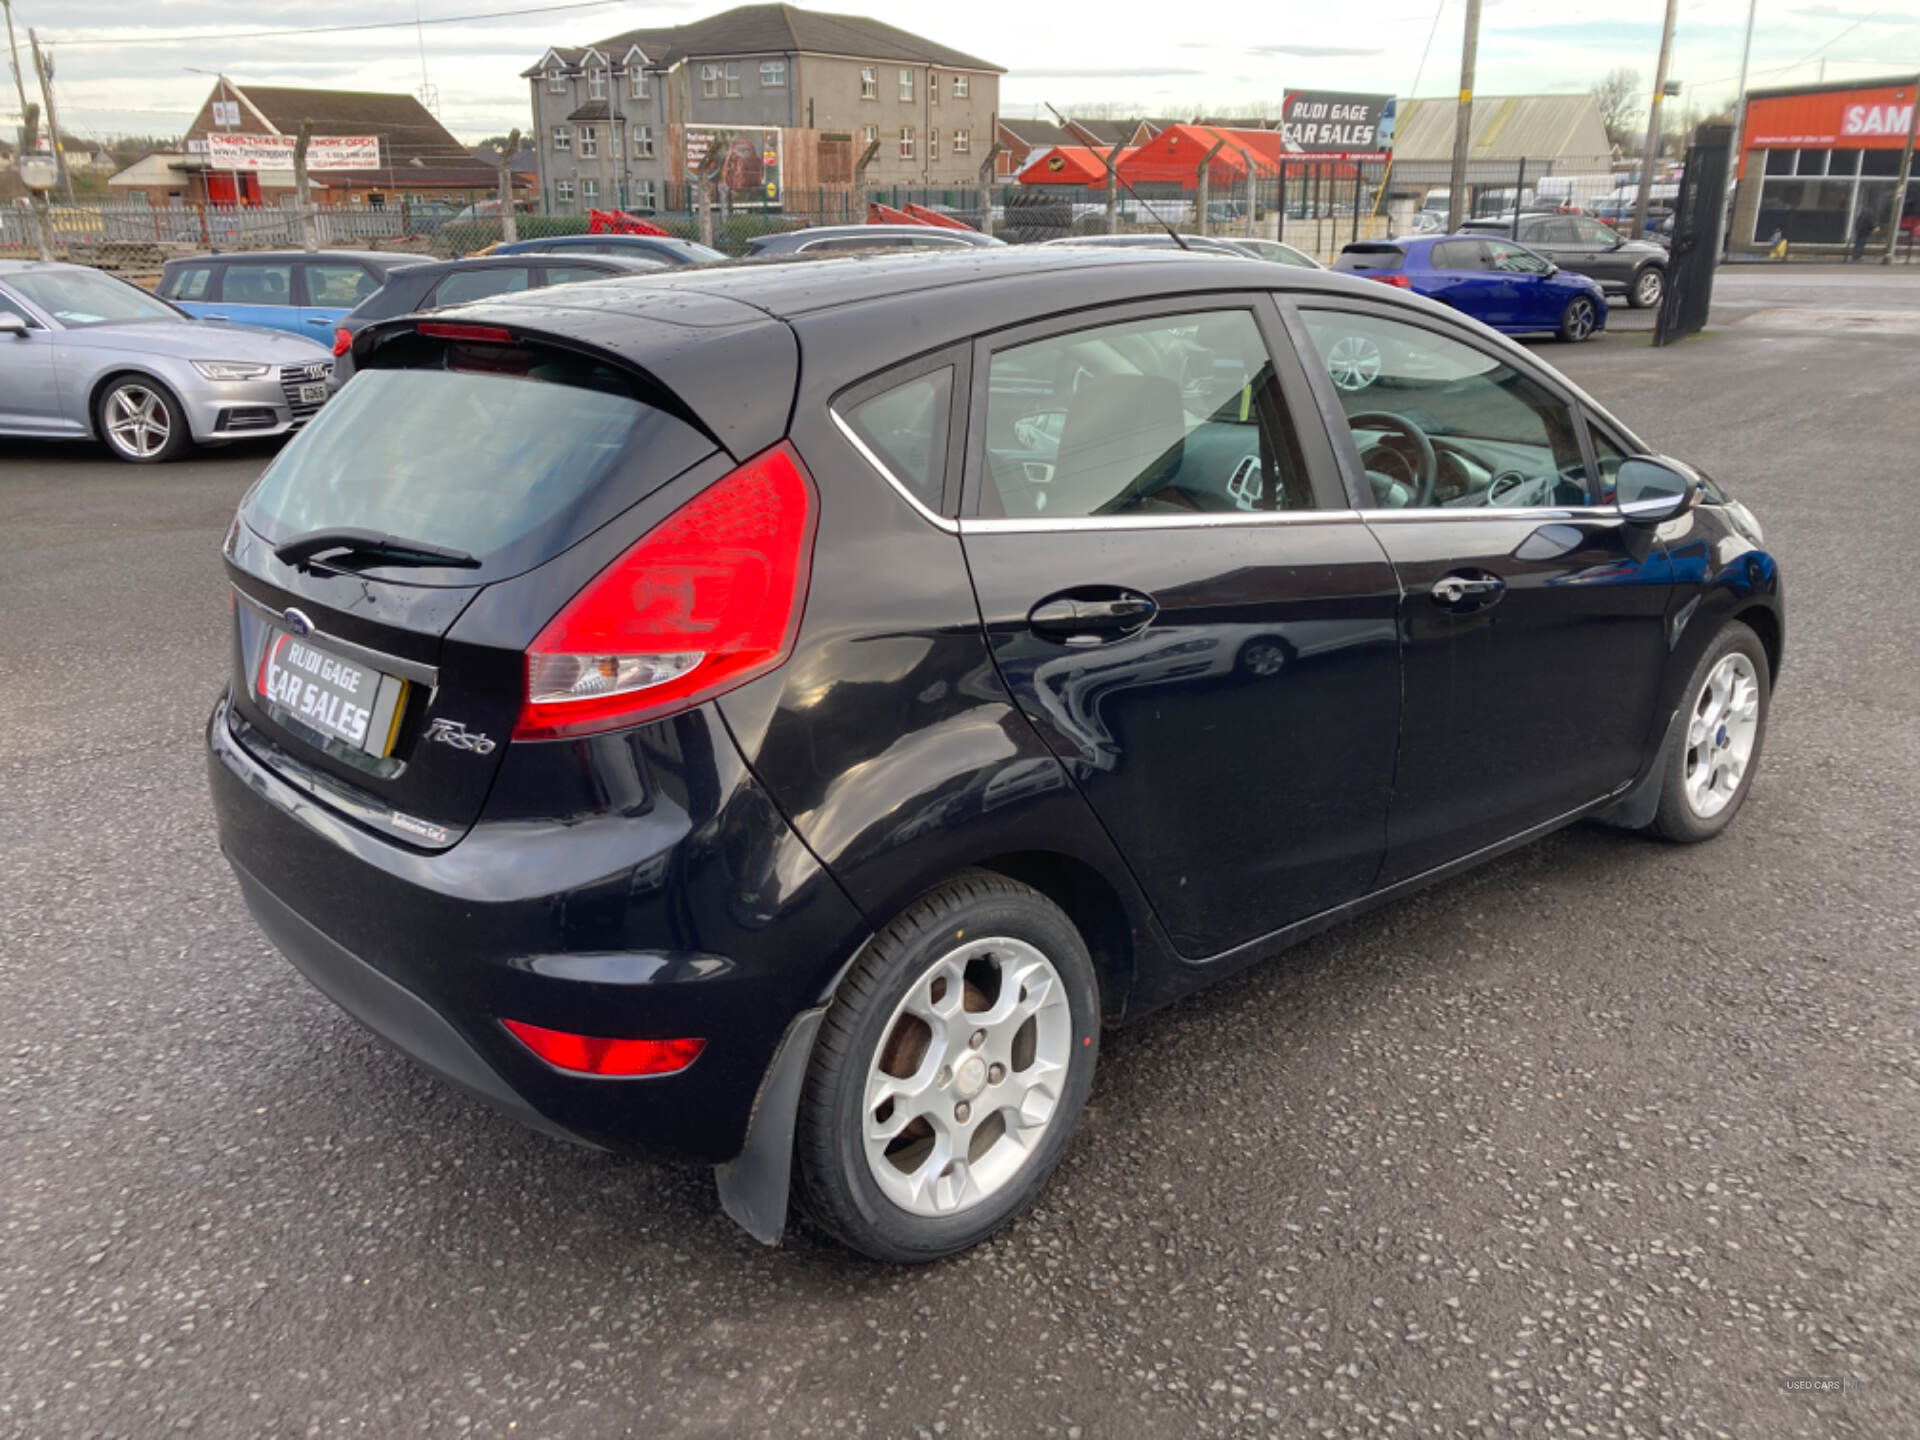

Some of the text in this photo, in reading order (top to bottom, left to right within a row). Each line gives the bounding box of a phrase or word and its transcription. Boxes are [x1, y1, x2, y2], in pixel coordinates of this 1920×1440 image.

[1292, 102, 1370, 121] RUDI GAGE
[1847, 105, 1913, 134] SAM
[211, 135, 279, 147] CHRISTMAS
[344, 137, 376, 147] OPEN
[1281, 122, 1375, 145] CAR SALES
[287, 642, 362, 693] RUDI GAGE
[266, 663, 304, 707] CAR
[300, 683, 370, 741] SALES
